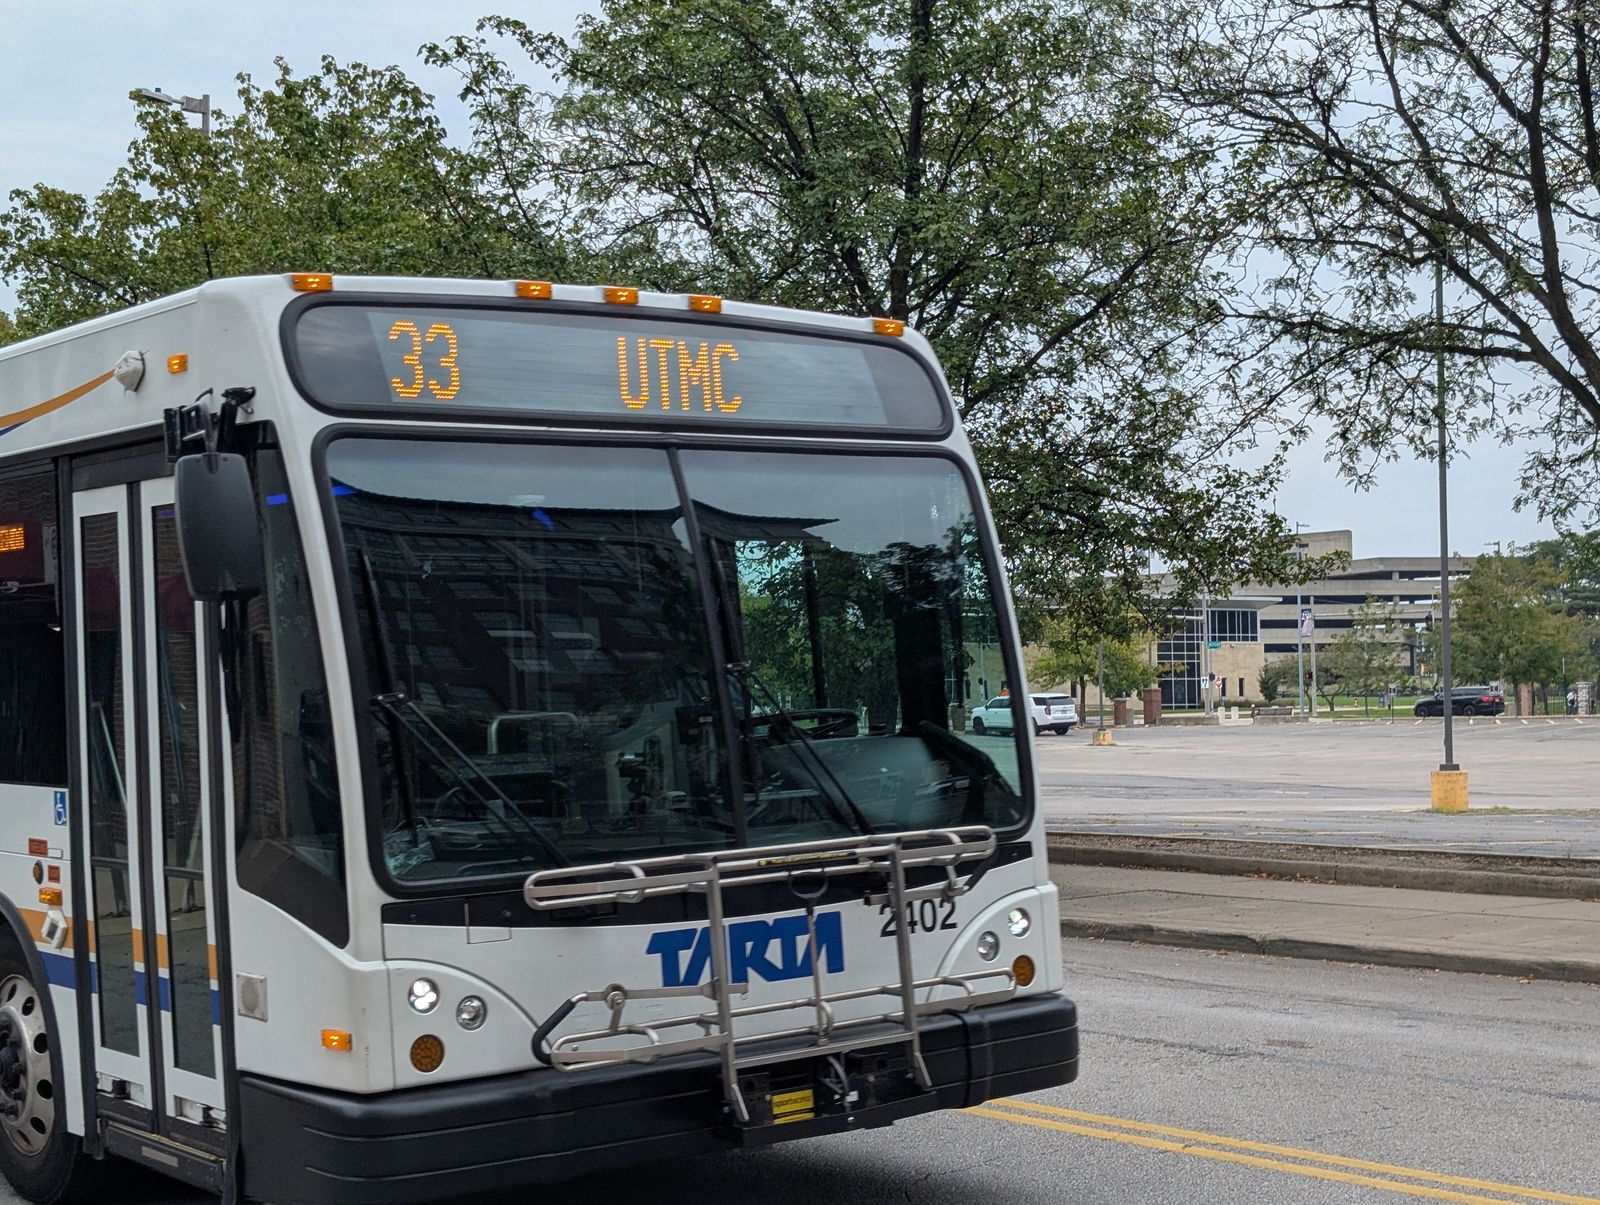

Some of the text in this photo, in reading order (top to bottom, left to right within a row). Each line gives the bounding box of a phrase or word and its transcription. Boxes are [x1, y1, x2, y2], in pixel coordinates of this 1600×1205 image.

[388, 320, 742, 413] 33 UTMC
[646, 911, 844, 987] TARTA
[879, 898, 958, 938] 2402
